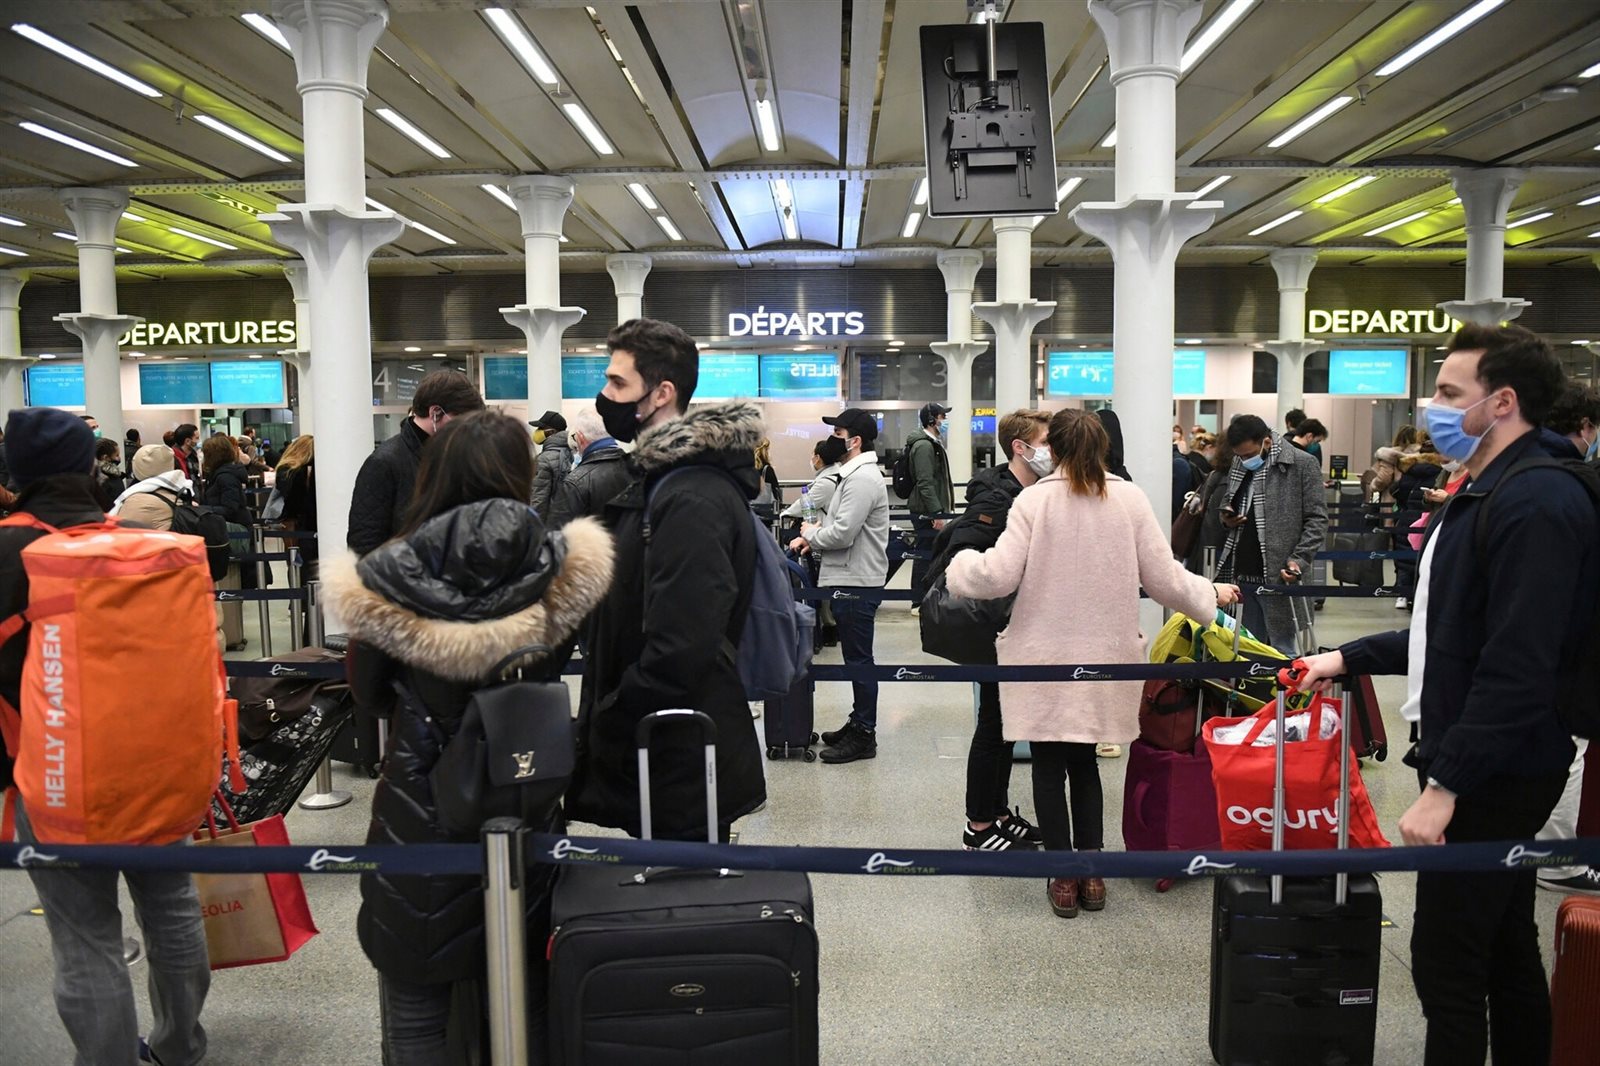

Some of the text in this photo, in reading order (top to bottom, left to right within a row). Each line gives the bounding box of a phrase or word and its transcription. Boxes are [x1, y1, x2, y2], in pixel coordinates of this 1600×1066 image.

[728, 305, 865, 336] DÉPARTS
[373, 366, 392, 393] 4
[931, 361, 948, 387] 3
[42, 624, 66, 808] HELLY HANSEN
[1226, 798, 1340, 834] ogury
[568, 852, 620, 862] EUROSTAR
[882, 865, 936, 874] EUROSTAR
